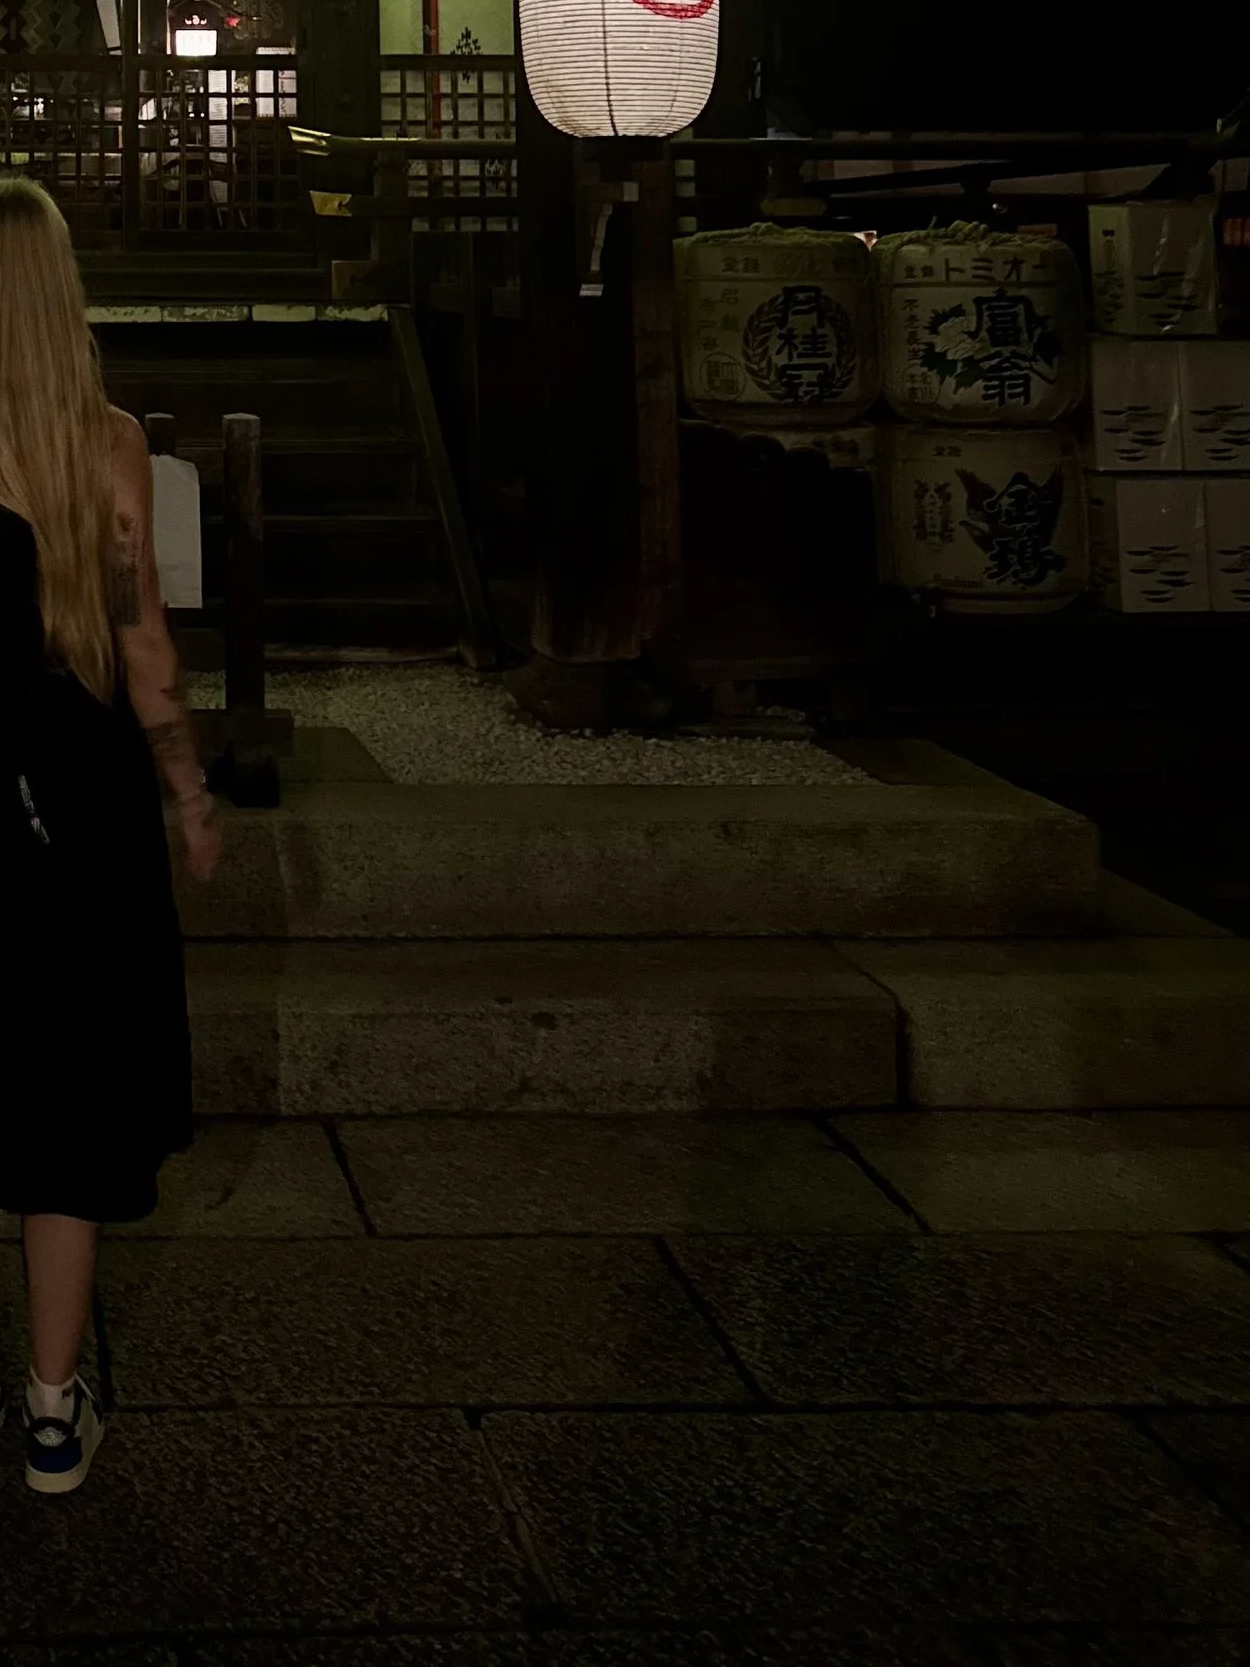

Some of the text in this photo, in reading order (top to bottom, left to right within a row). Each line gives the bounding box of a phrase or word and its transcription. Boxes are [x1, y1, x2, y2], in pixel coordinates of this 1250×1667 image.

[774, 285, 832, 404] 月桂冠
[965, 288, 1039, 407] 富翁
